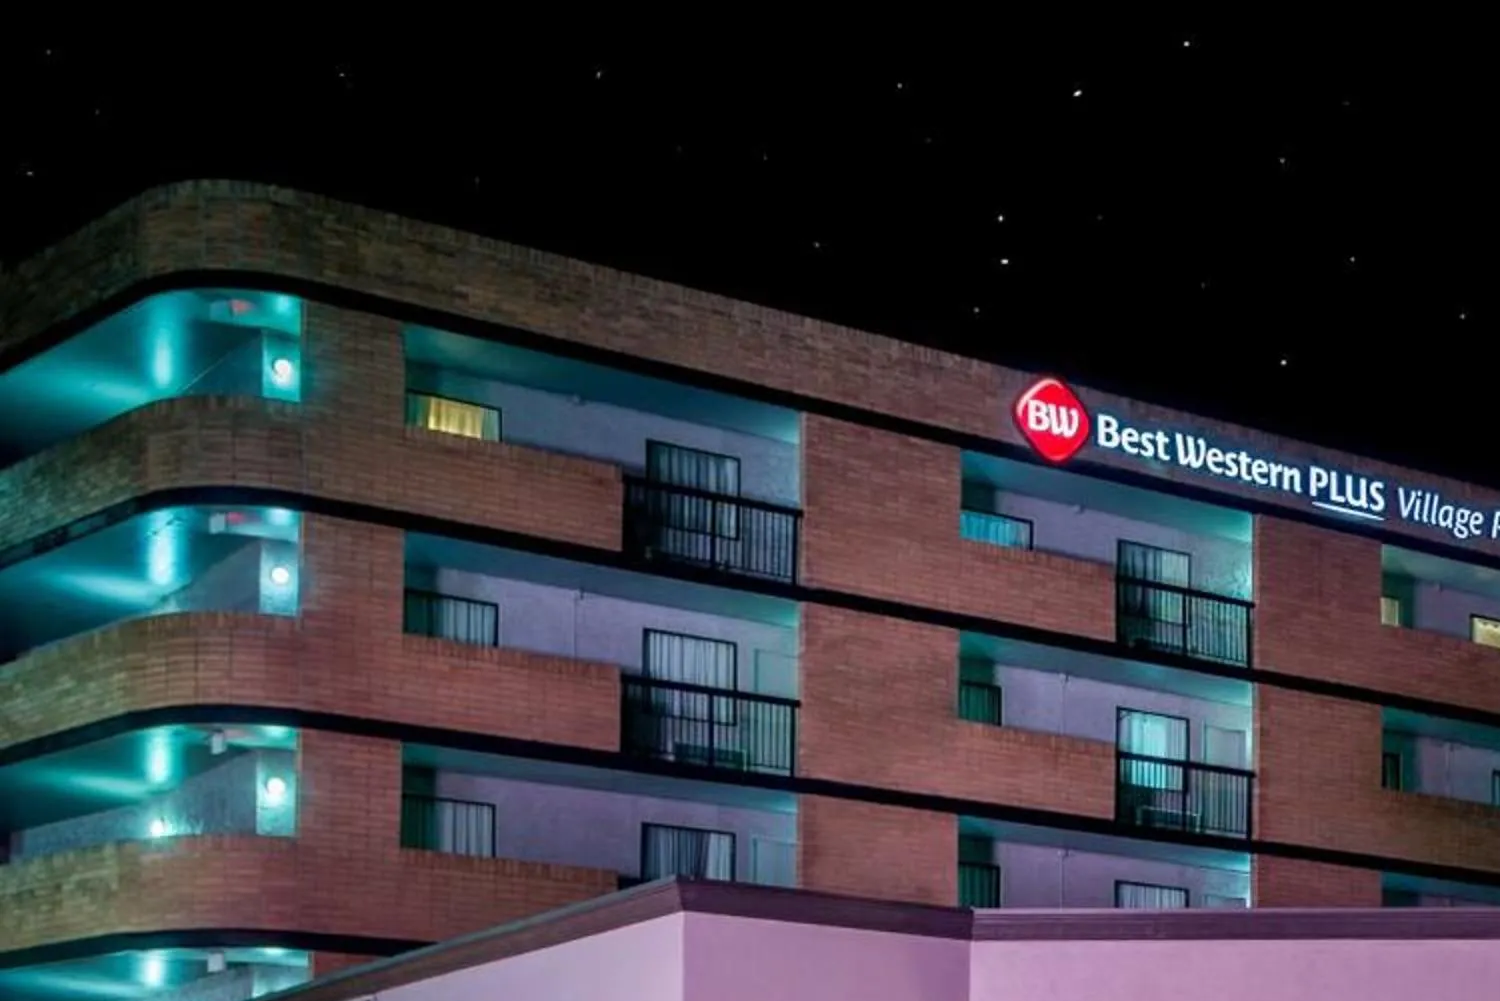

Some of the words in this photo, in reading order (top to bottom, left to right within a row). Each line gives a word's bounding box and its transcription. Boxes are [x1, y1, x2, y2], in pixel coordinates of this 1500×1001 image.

[1027, 400, 1079, 438] BW
[1098, 414, 1170, 463] Best
[1175, 431, 1302, 494] Western
[1309, 465, 1386, 512] PLUS
[1398, 487, 1484, 539] Village
